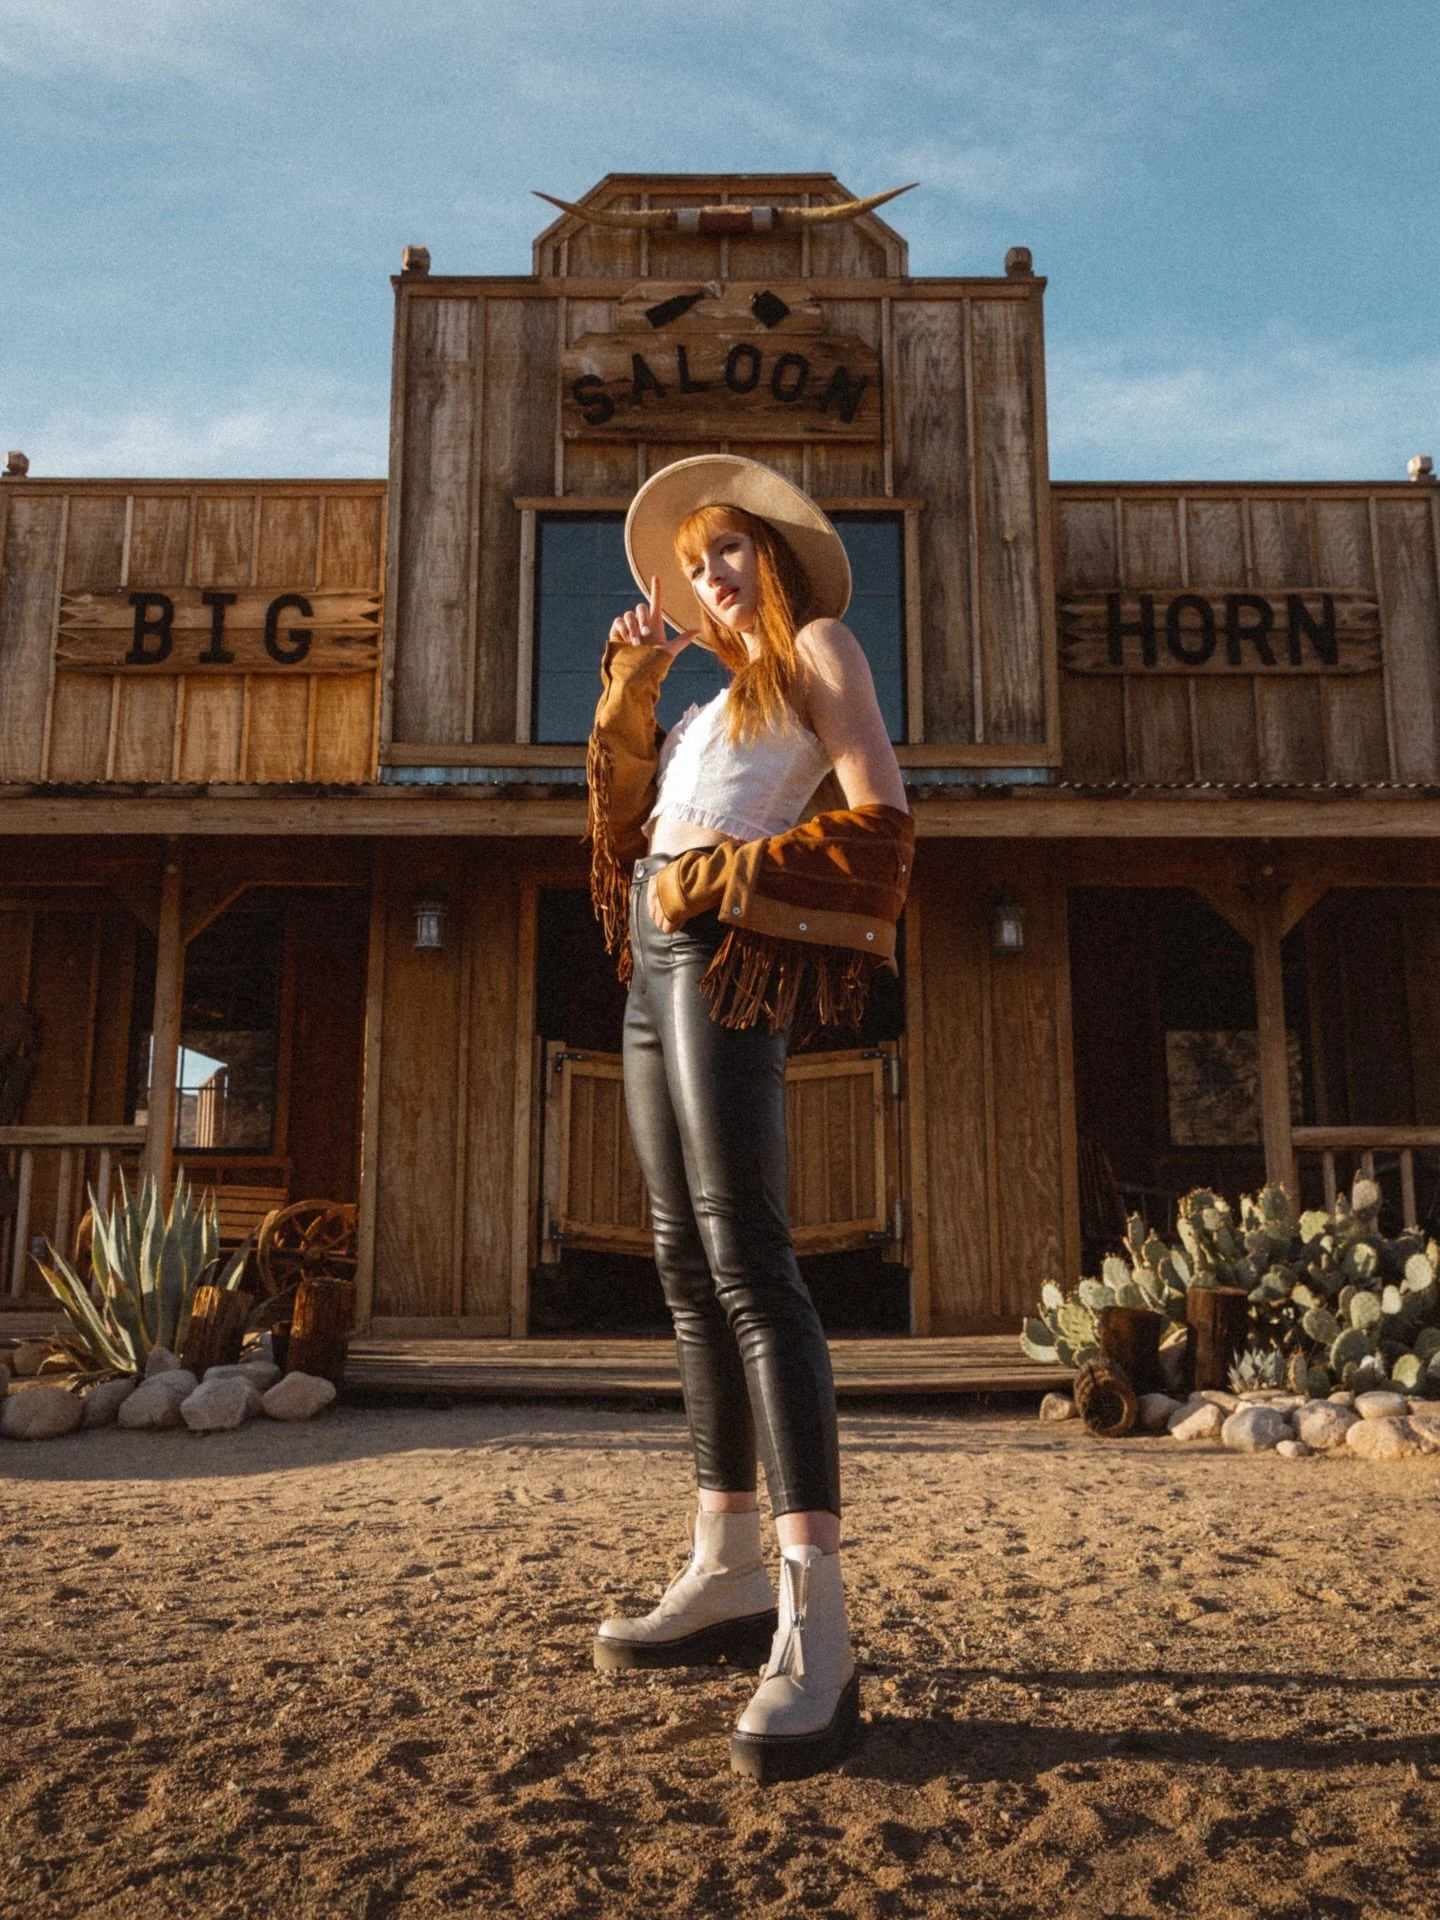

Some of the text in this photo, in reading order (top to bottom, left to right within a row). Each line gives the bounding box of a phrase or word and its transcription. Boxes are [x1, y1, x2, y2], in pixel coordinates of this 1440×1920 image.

[571, 343, 870, 425] SALOON
[125, 592, 314, 665] BIG
[1106, 592, 1338, 668] HORN
